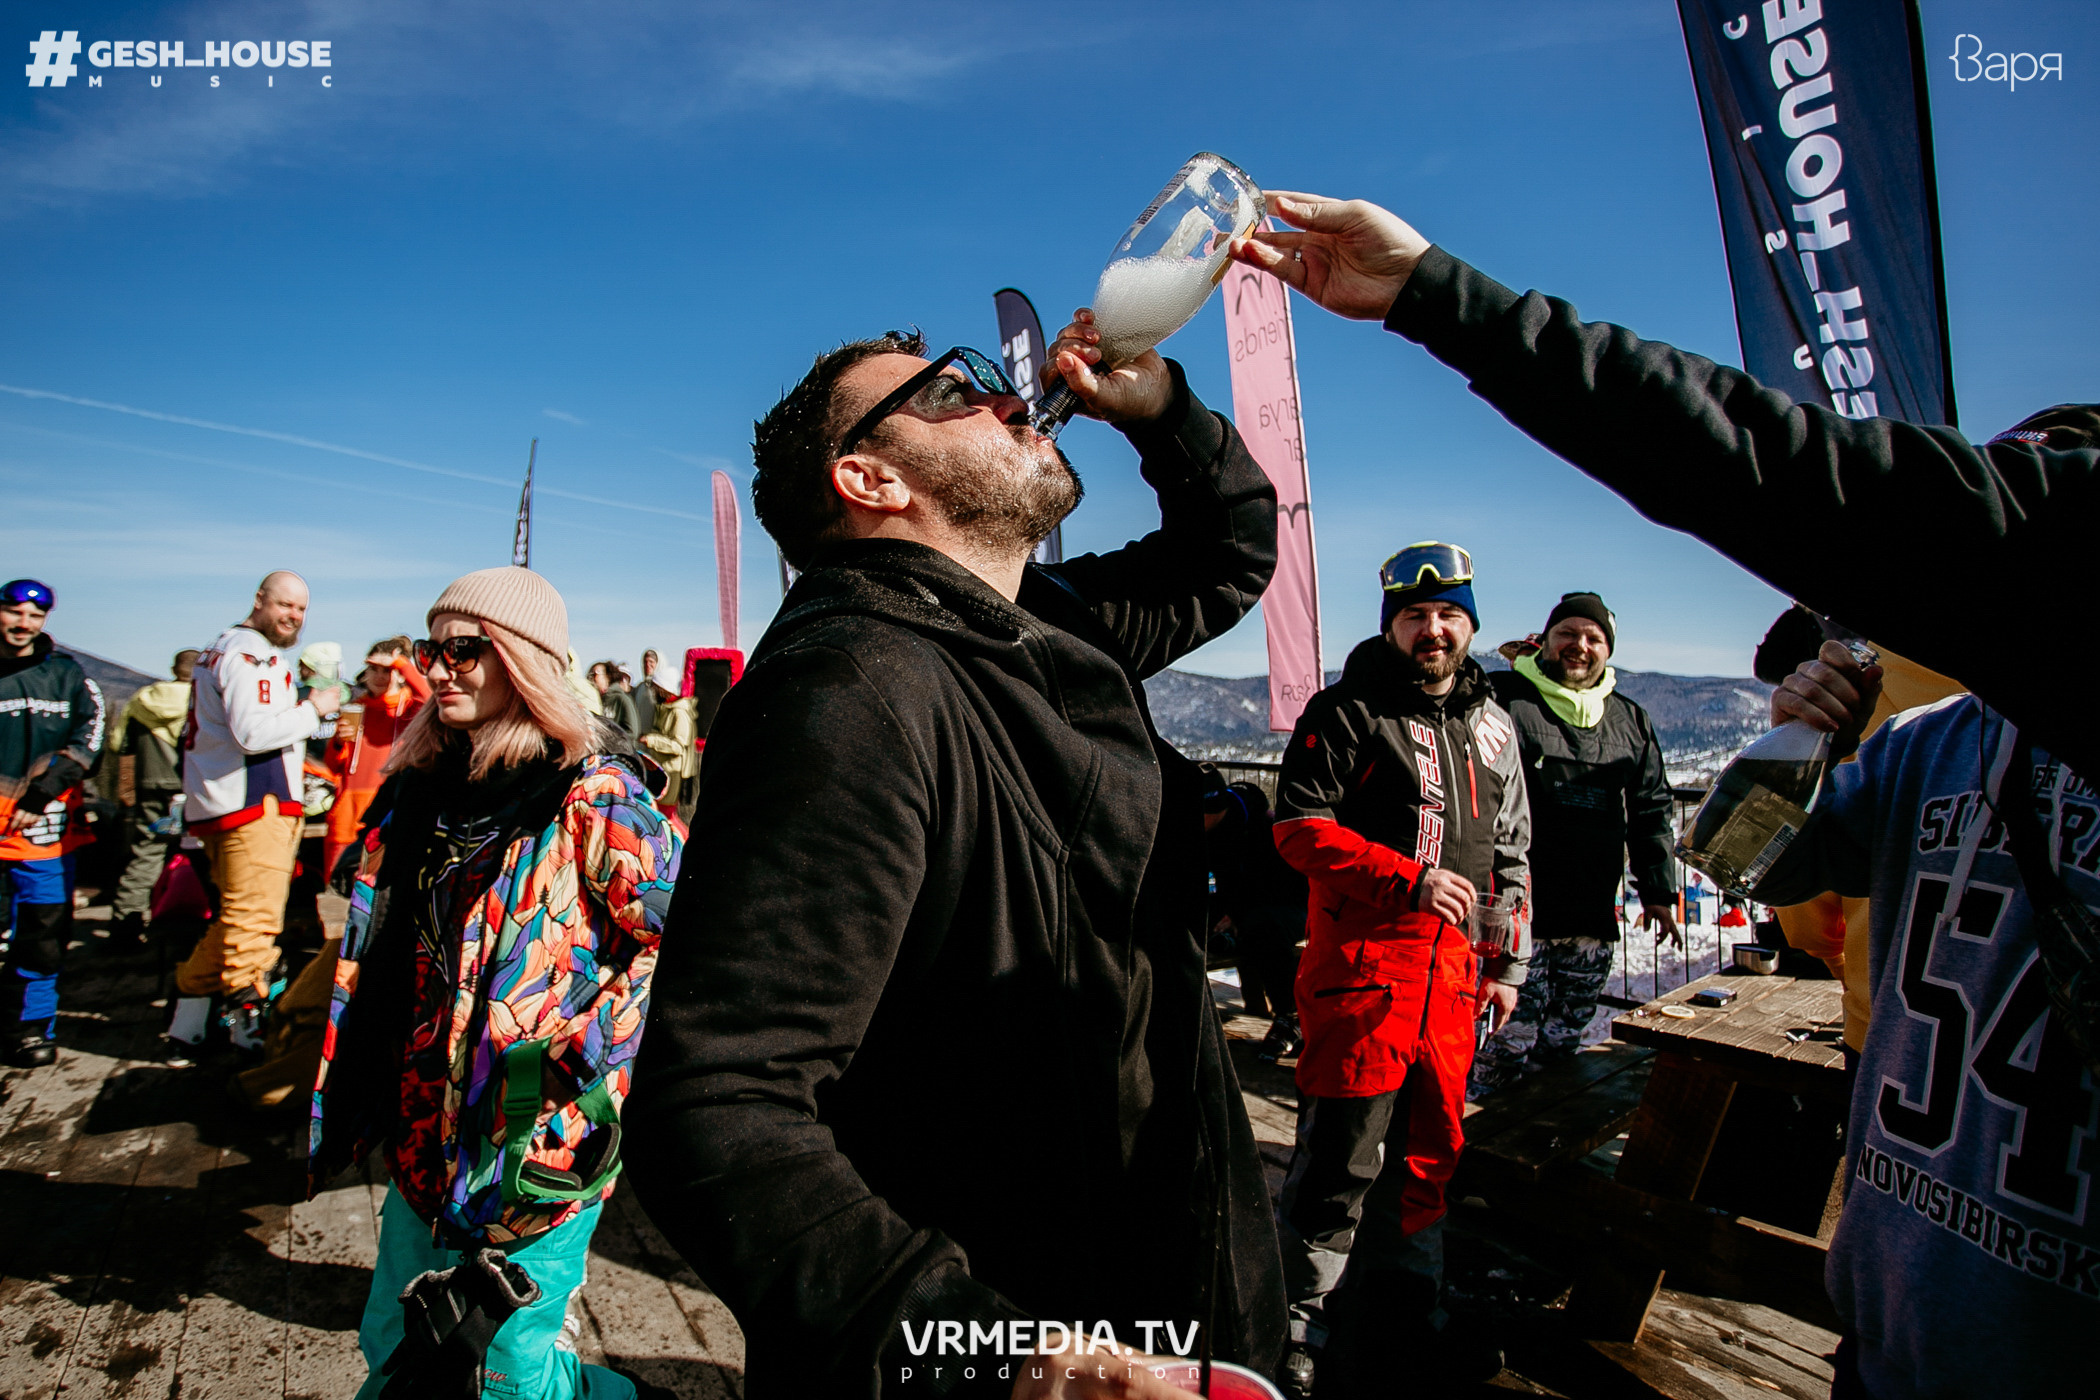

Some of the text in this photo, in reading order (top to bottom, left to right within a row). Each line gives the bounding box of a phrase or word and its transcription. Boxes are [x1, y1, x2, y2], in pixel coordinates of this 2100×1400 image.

[258, 679, 271, 704] 8
[1409, 720, 1445, 869] SENTELE
[1875, 869, 2099, 1227] 54
[1857, 1143, 2100, 1300] NOVOSIBIRSK
